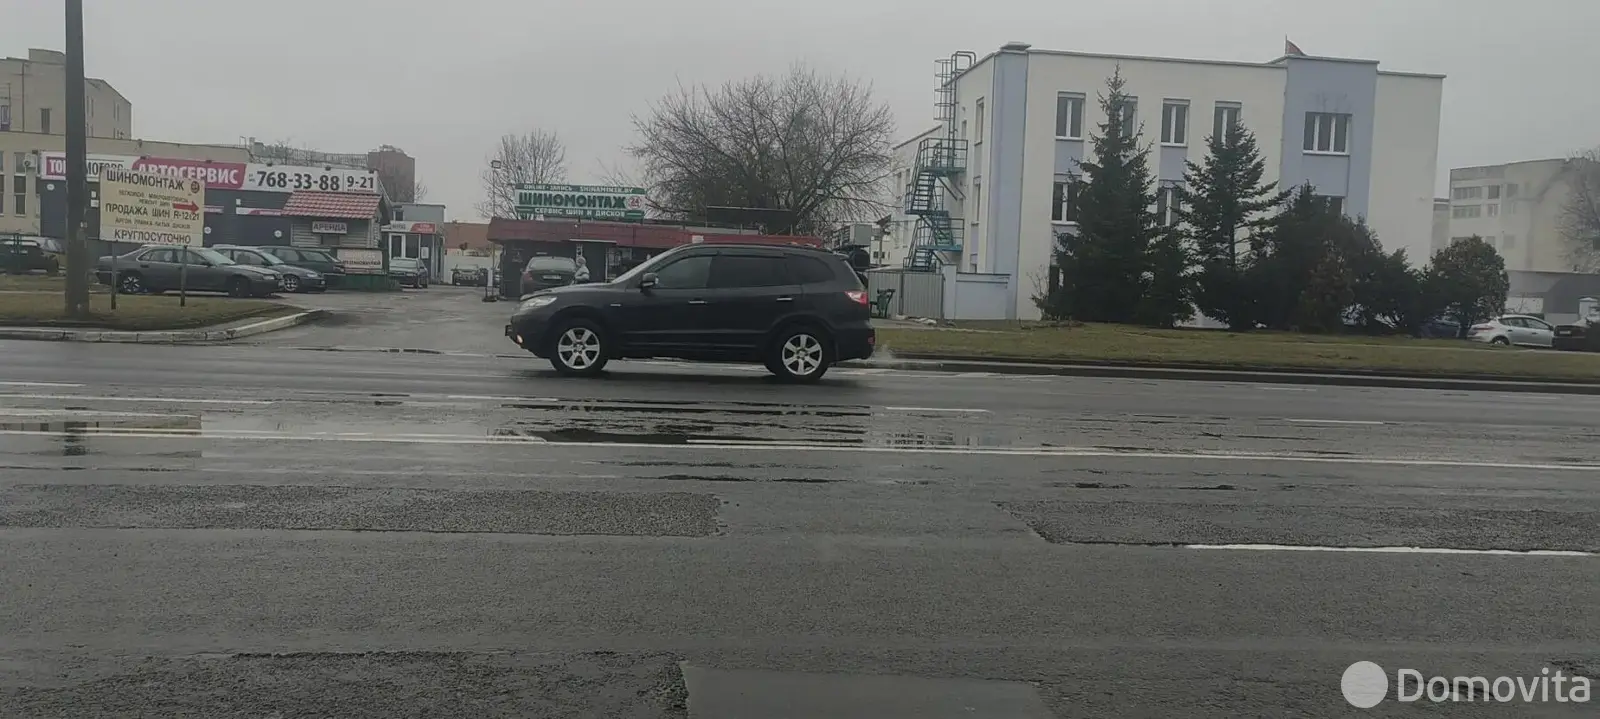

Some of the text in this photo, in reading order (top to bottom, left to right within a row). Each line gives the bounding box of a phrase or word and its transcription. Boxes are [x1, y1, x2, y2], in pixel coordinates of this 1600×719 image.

[106, 169, 185, 191] ШИНОМОНТАЖ
[138, 163, 239, 185] АВТОСЕРВИС
[256, 170, 340, 191] 768-33-88
[346, 175, 374, 189] 9-21
[518, 191, 626, 209] ШИНОМОНТАЖ
[105, 203, 148, 216] ПРОДАЖА
[152, 208, 170, 218] ШИН
[534, 207, 562, 215] СЕРВИС
[566, 208, 583, 216] ШИН
[313, 223, 346, 232] АРЕНДА
[114, 228, 191, 244] КРУГЛОСУТОЧНО
